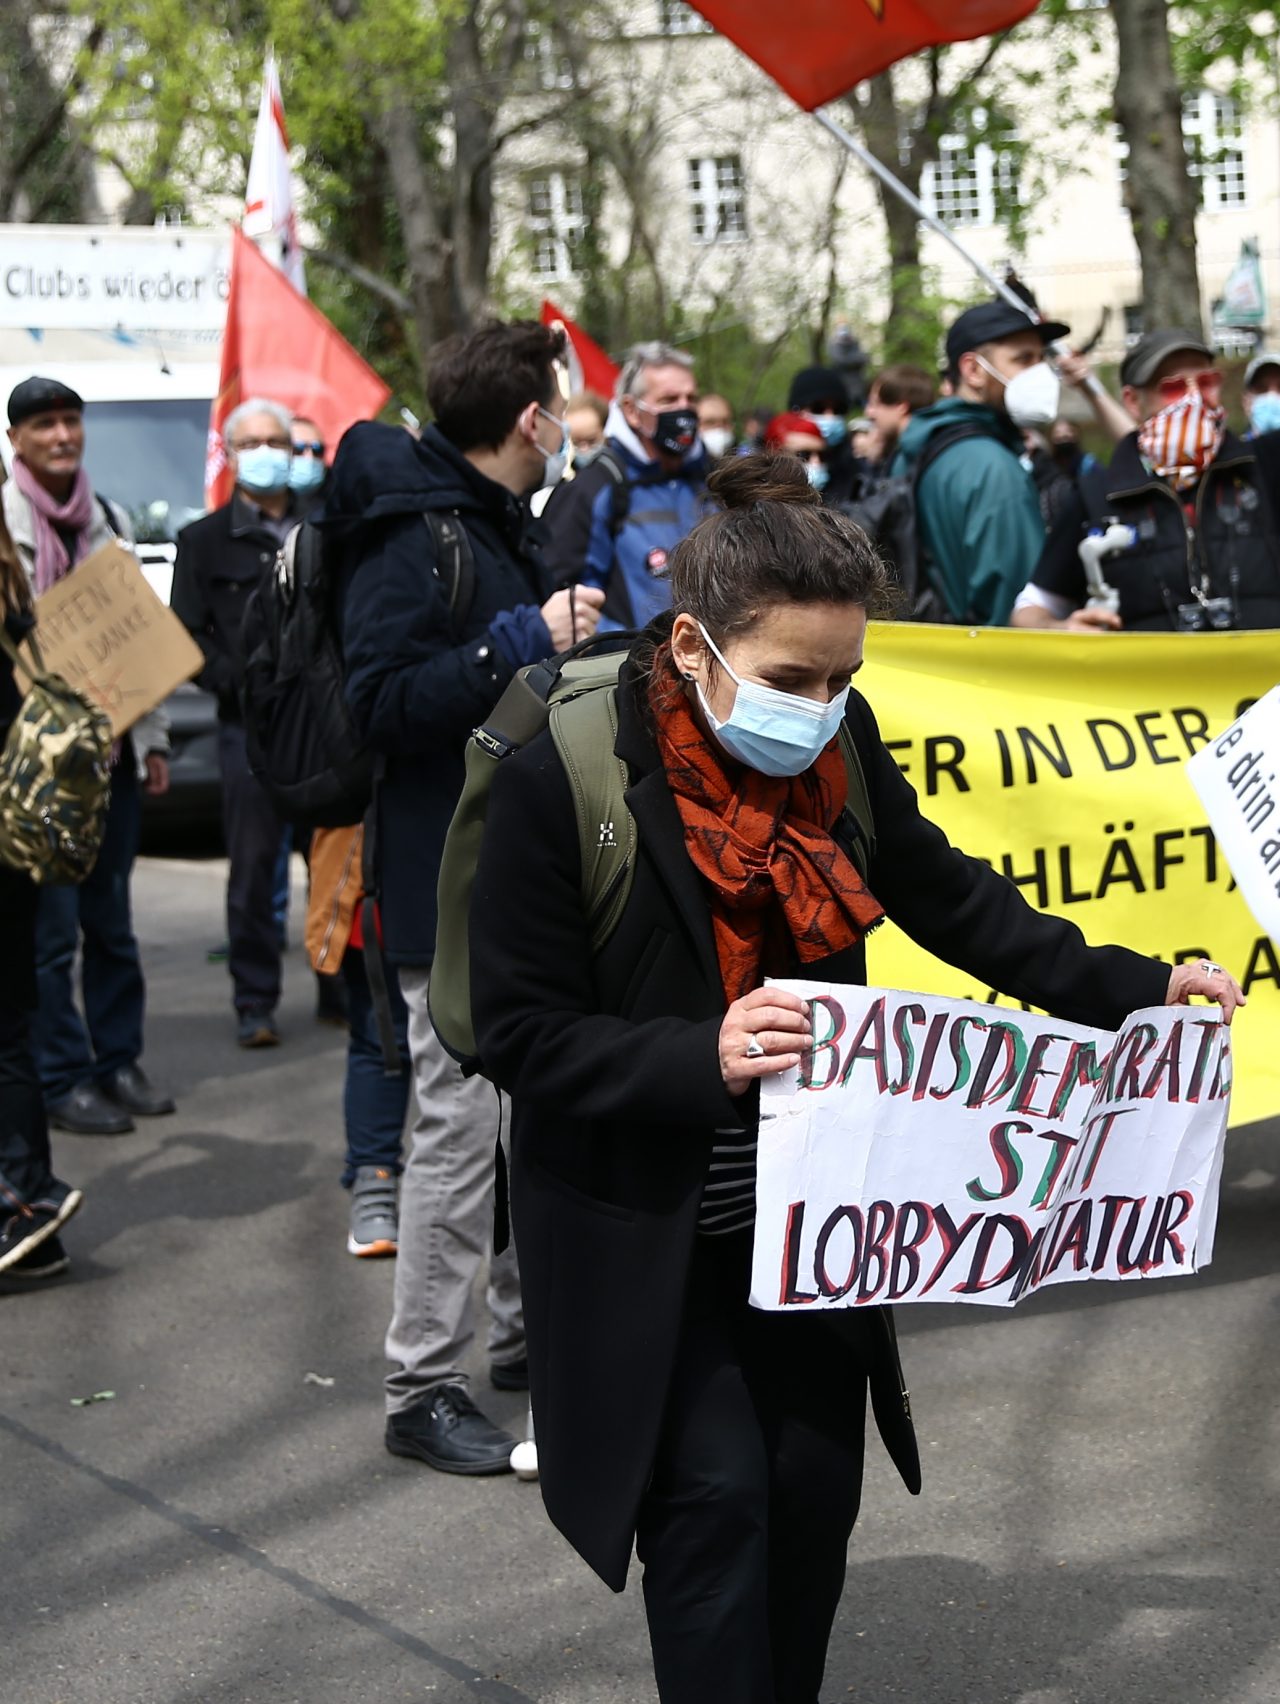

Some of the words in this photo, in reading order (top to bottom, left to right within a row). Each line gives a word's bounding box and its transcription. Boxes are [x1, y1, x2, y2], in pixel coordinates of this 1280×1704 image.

[6, 267, 90, 299] Clubs
[104, 270, 204, 302] wieder
[215, 268, 232, 301] ö
[995, 723, 1074, 788] IN
[1085, 706, 1214, 773] DER
[1227, 750, 1276, 833] drin
[978, 820, 1238, 909] HLÄFT,
